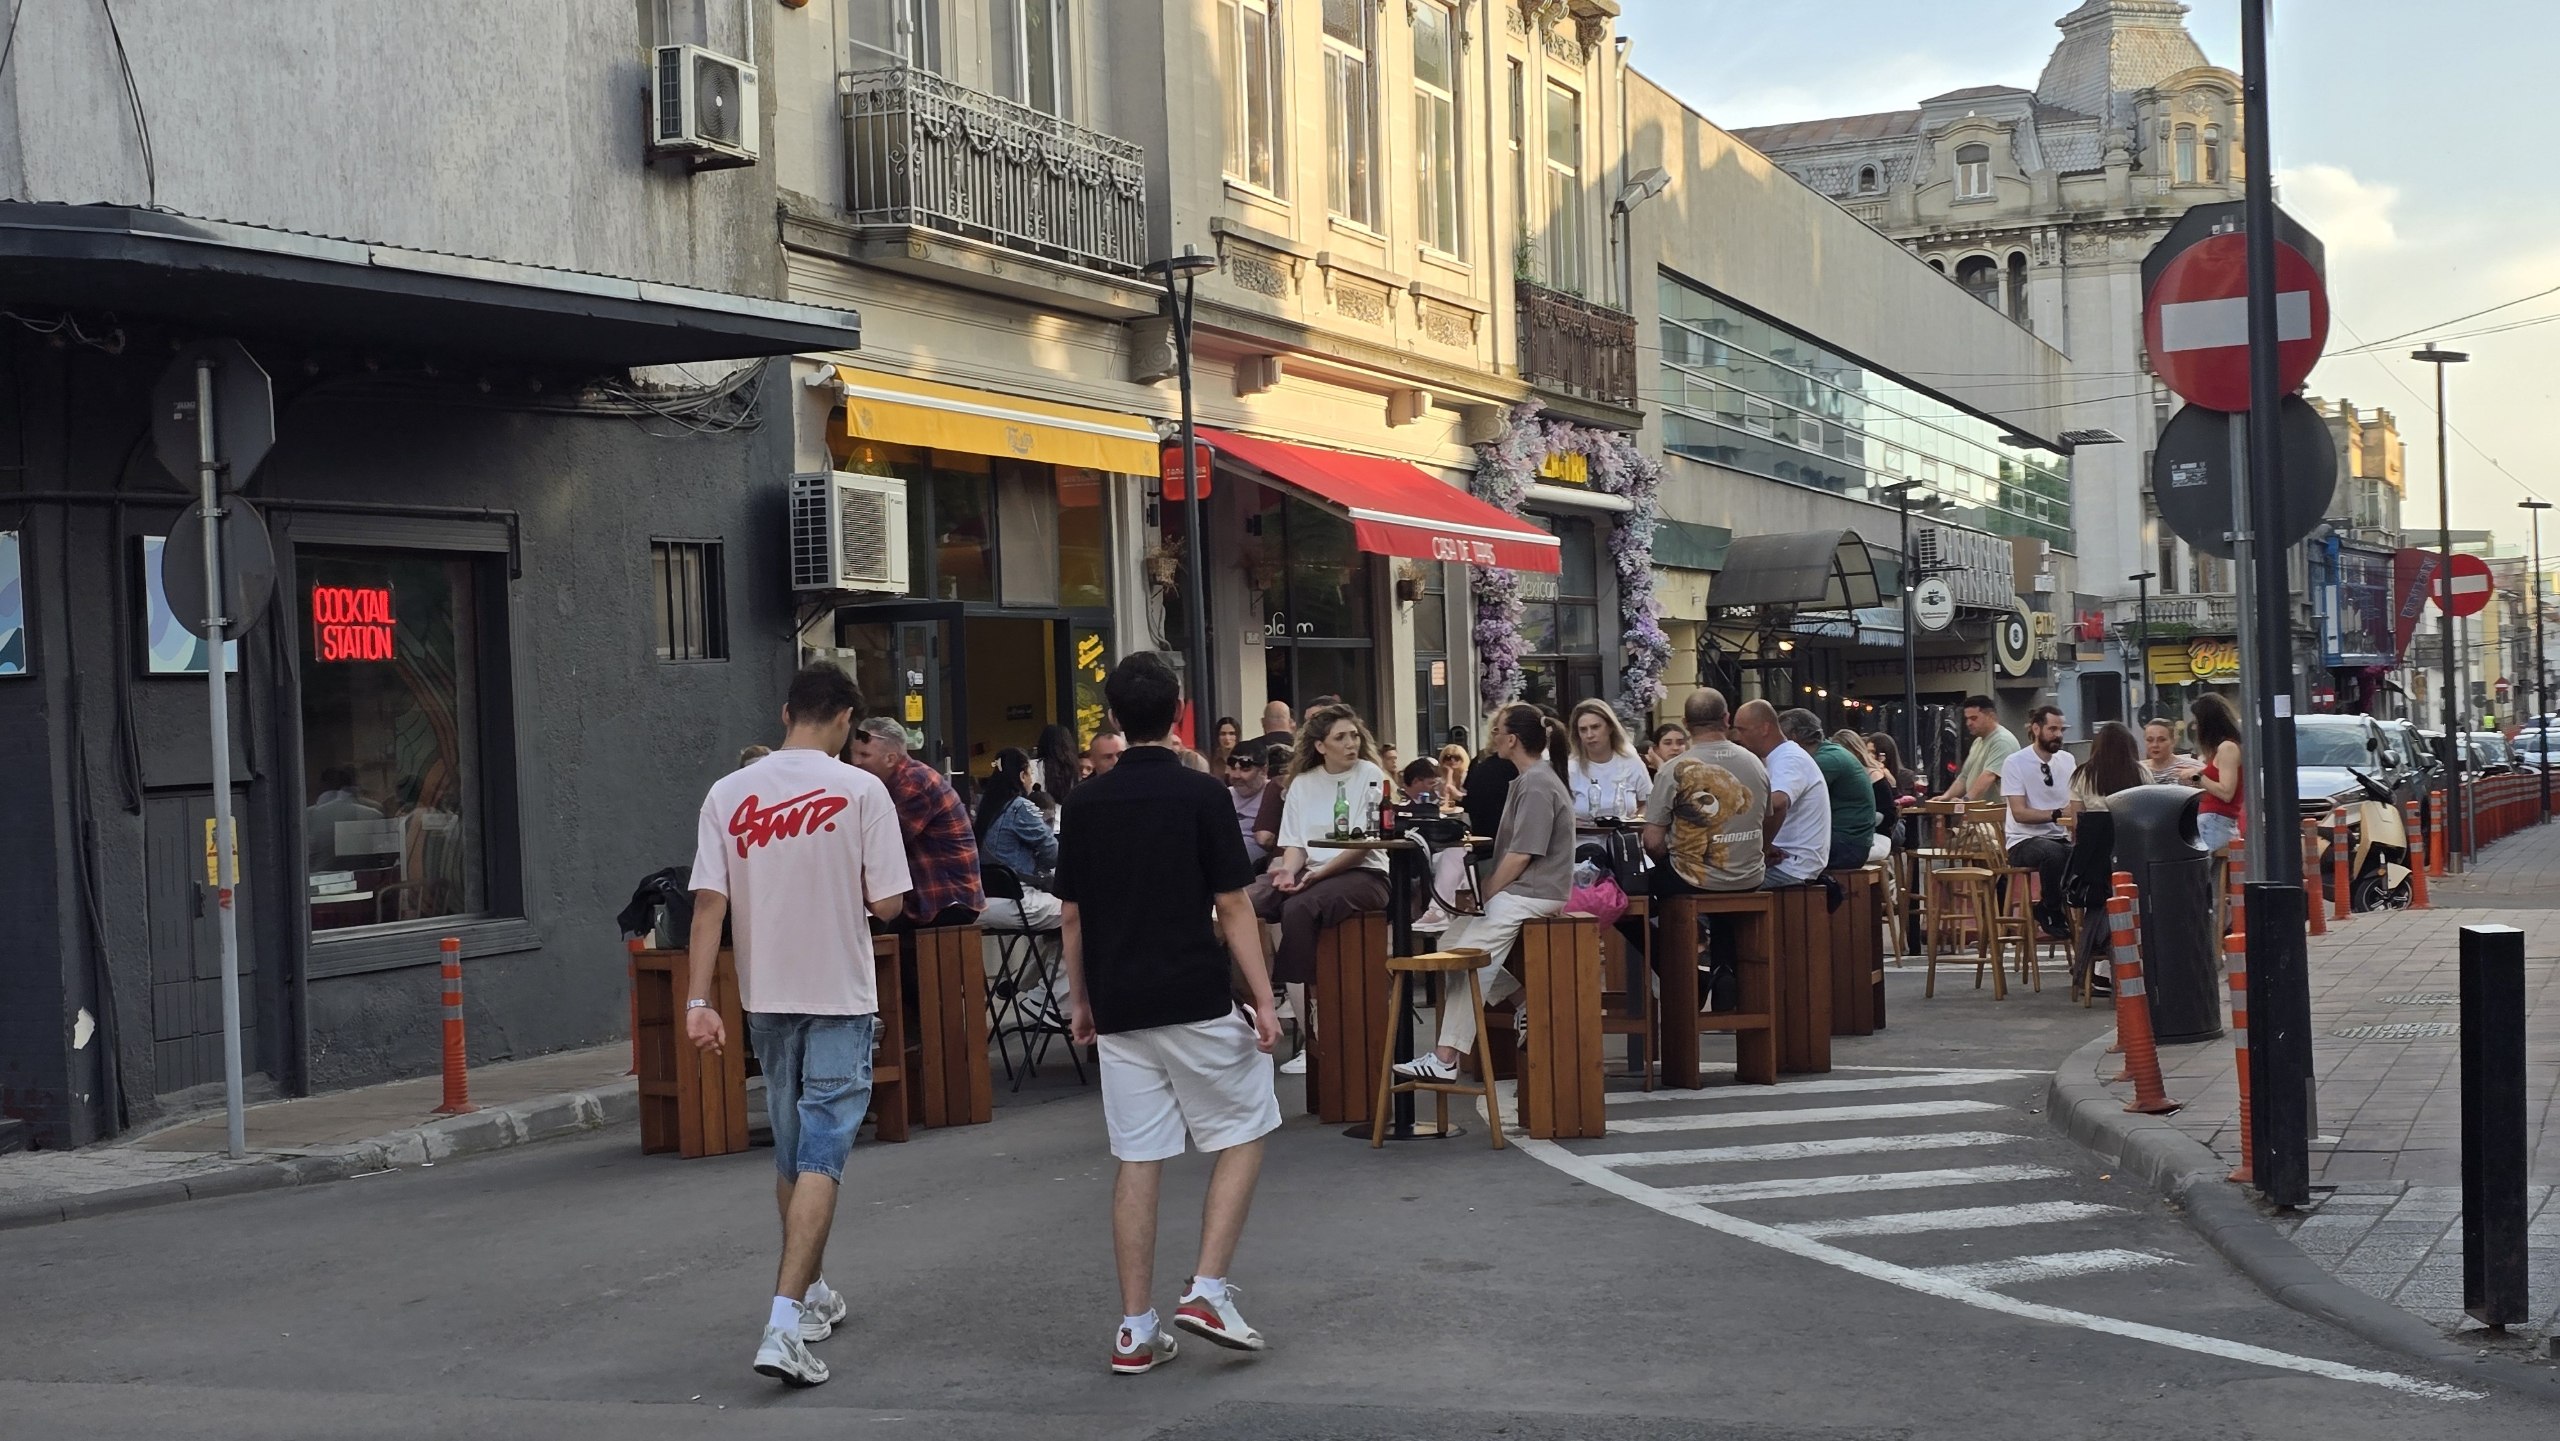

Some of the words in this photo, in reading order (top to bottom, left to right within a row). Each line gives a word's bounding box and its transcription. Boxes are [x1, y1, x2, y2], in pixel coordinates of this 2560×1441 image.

[1456, 539, 1473, 562] DE
[315, 587, 396, 624] COCKTAIL
[323, 625, 392, 660] STATION
